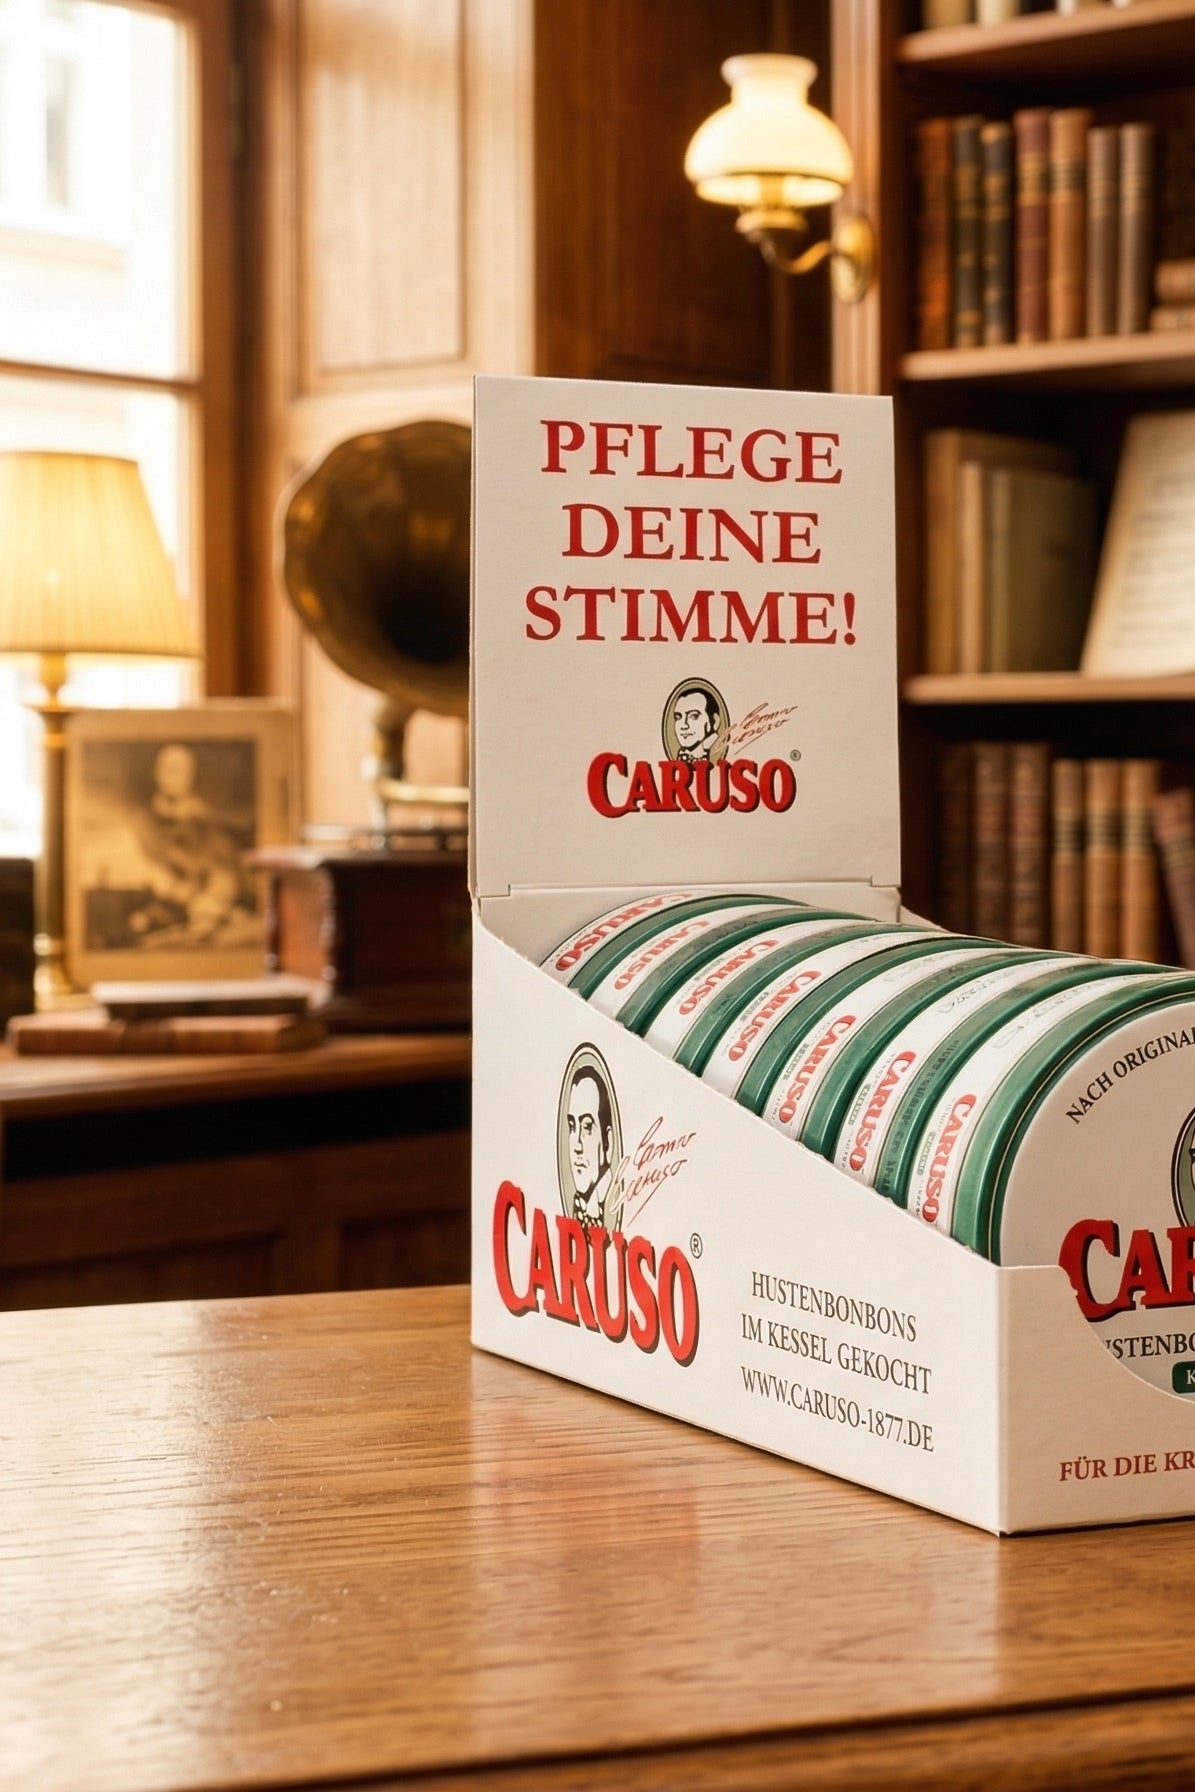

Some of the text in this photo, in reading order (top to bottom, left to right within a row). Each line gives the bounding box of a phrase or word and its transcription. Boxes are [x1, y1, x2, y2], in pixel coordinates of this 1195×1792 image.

[540, 420, 842, 484] PFLEGE
[562, 503, 821, 564] DEINE
[525, 585, 856, 645] STIMME!
[587, 752, 797, 818] CARUSO
[778, 1015, 857, 1123] CARUSO
[1066, 1073, 1113, 1124] NACH
[849, 1051, 917, 1171] CARUSO
[921, 1093, 977, 1223] CARUSO
[493, 1181, 699, 1367] CARUSO
[751, 1271, 916, 1342] HUSTENBONBONS
[741, 1314, 932, 1395] IM KESSEL GEKOCHT
[741, 1366, 934, 1452] WWW.CARUSO-1877.DE
[1059, 1456, 1108, 1482] FÜR
[1115, 1454, 1157, 1476] DIE
